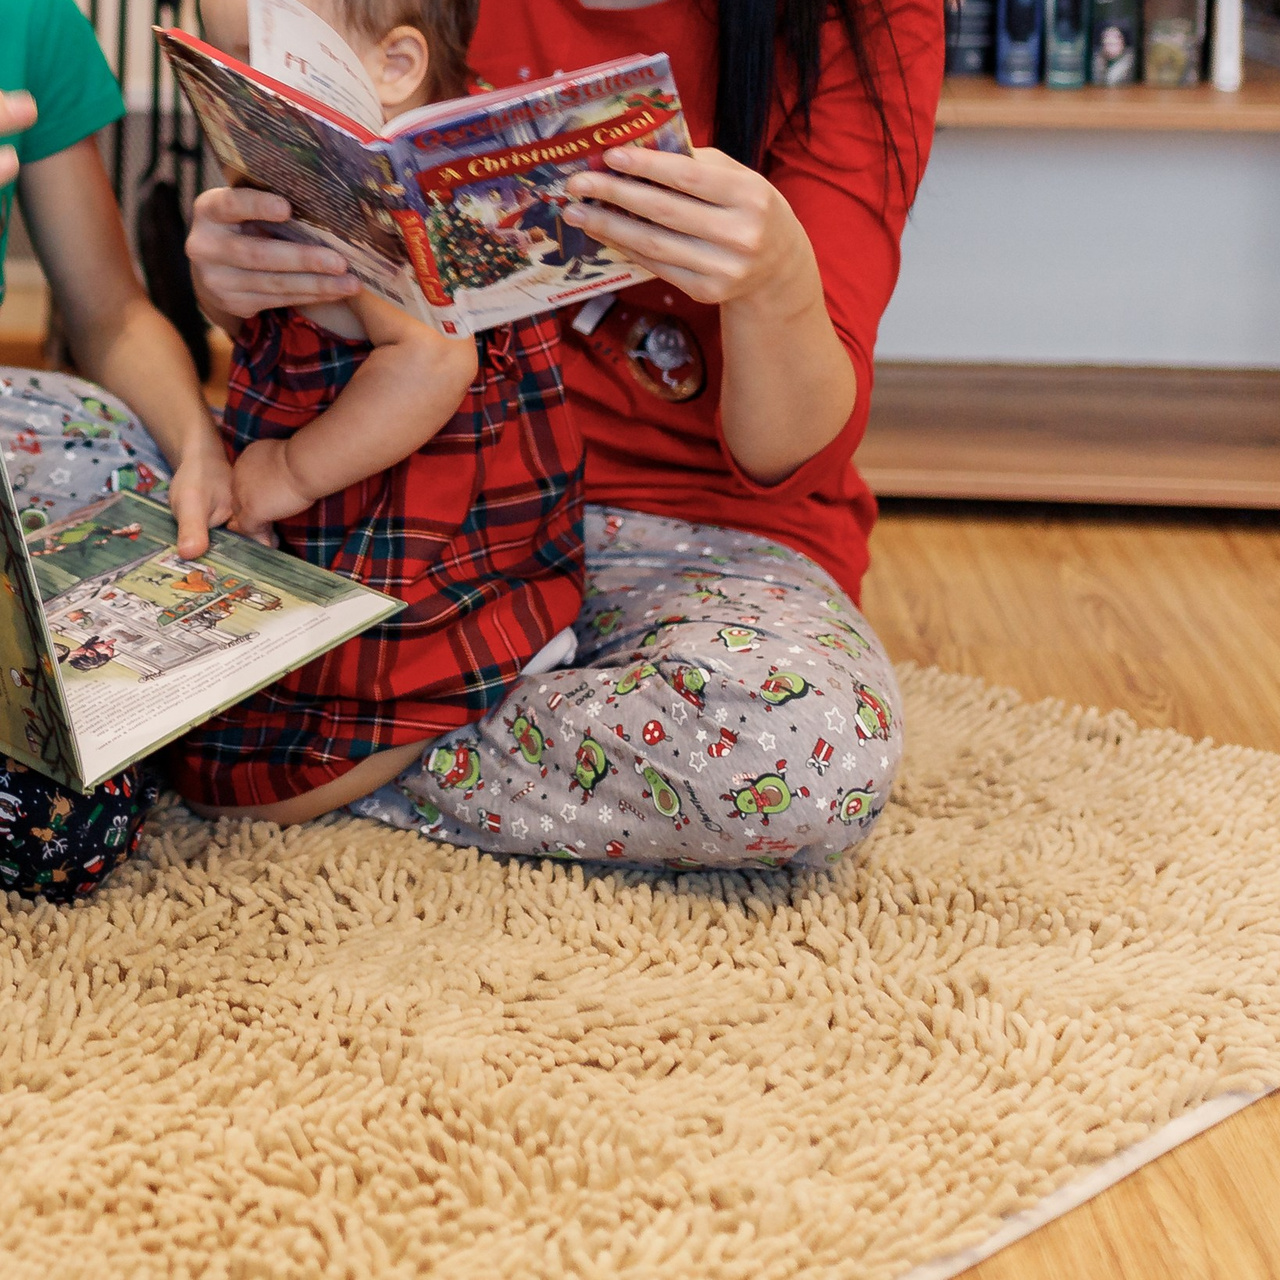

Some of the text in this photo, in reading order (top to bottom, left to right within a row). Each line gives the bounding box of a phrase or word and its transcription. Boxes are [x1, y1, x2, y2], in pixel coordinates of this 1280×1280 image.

[438, 110, 656, 186] A Christmas Carol
